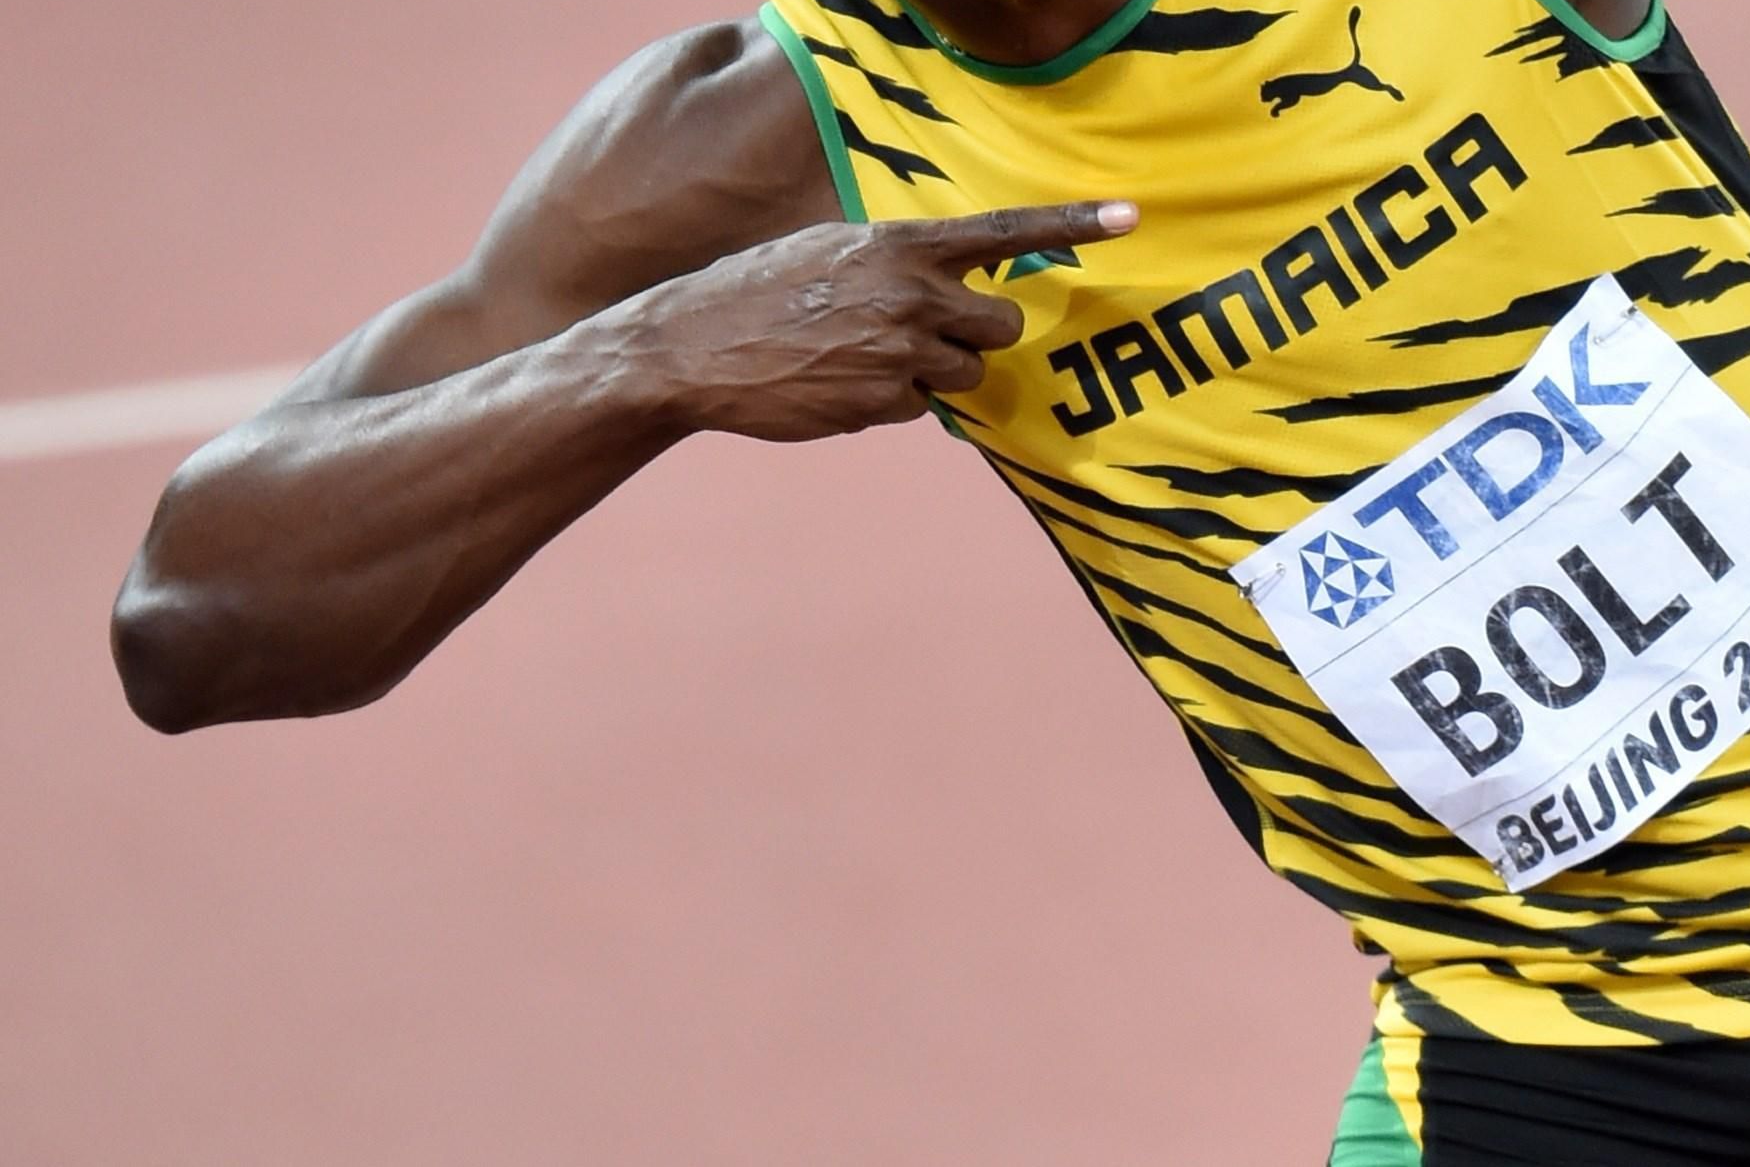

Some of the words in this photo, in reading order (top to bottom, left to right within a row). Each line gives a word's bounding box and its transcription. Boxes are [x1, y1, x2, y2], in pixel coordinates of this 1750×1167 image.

[1048, 113, 1527, 436] JAMAICA
[1354, 323, 1652, 561] TDK
[1391, 452, 1735, 778] BOLT
[1496, 684, 1720, 874] BEIJING
